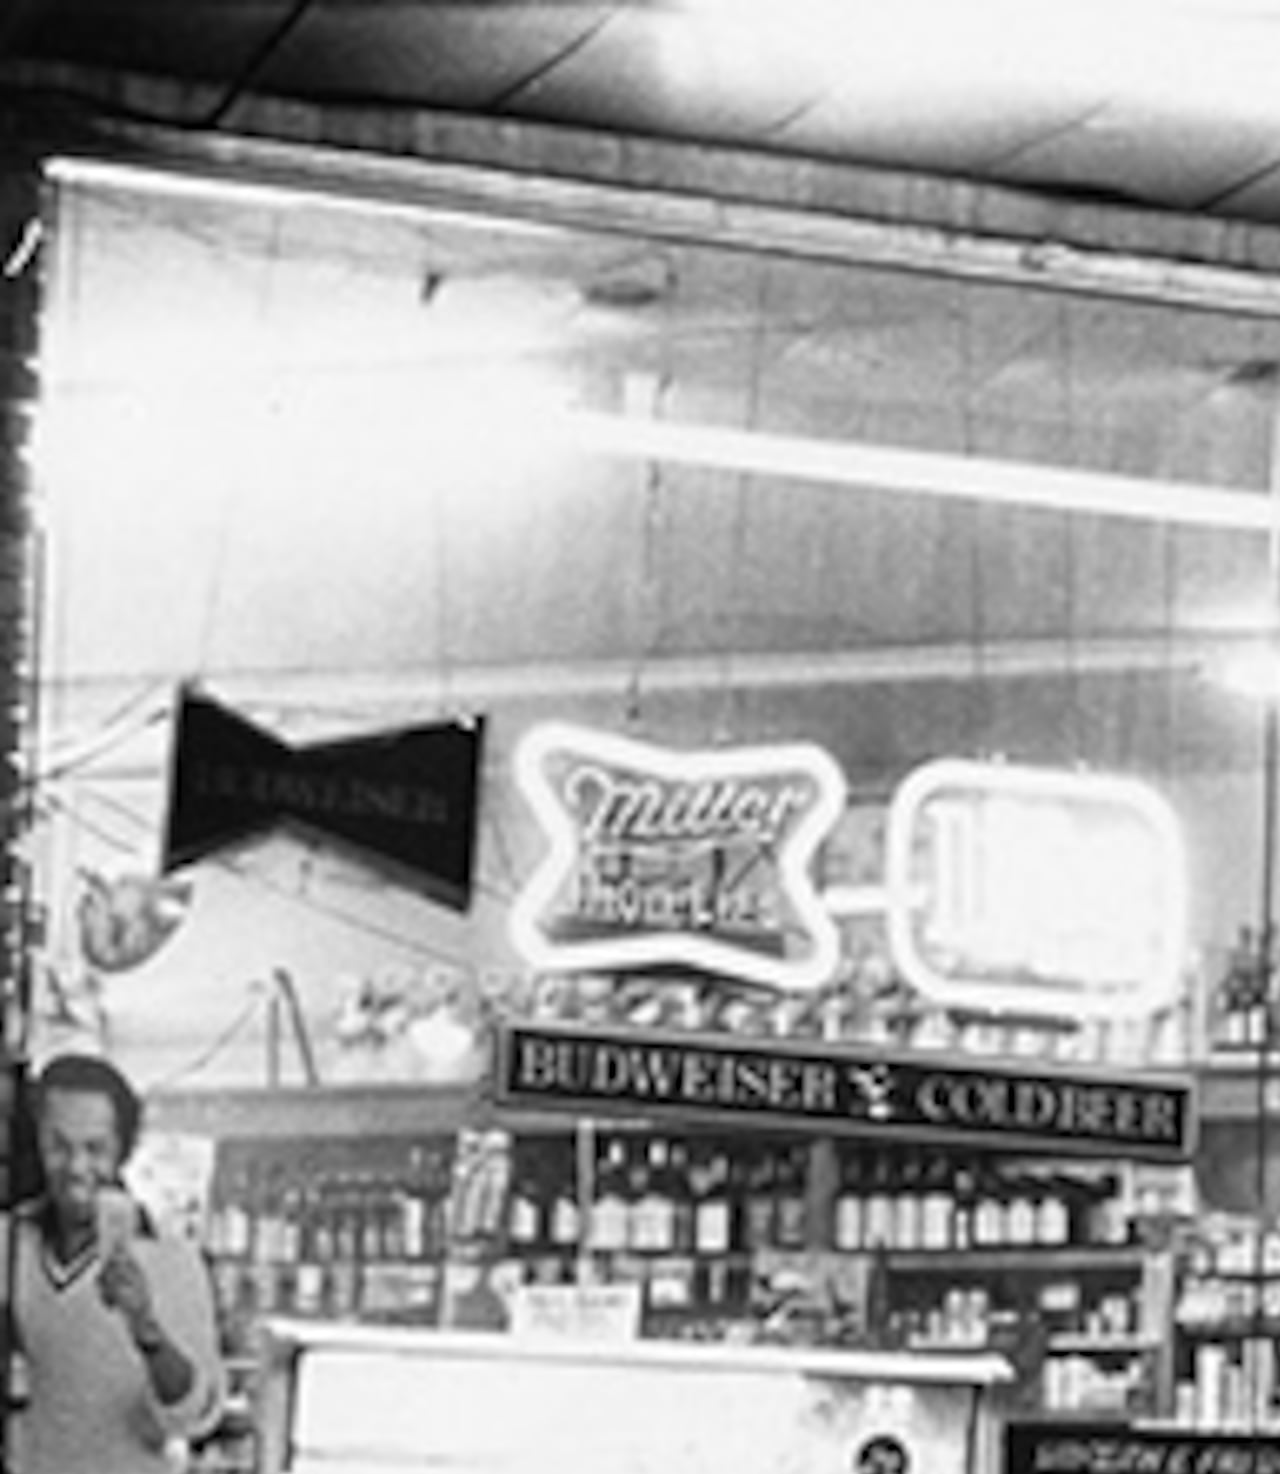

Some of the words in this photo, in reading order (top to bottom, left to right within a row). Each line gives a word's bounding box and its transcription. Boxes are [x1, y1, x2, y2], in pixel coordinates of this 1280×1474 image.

[564, 767, 808, 841] Miller
[521, 1041, 837, 1110] BUDWEISER
[916, 1074, 1054, 1127] COLD
[1056, 1086, 1176, 1138] BEER
